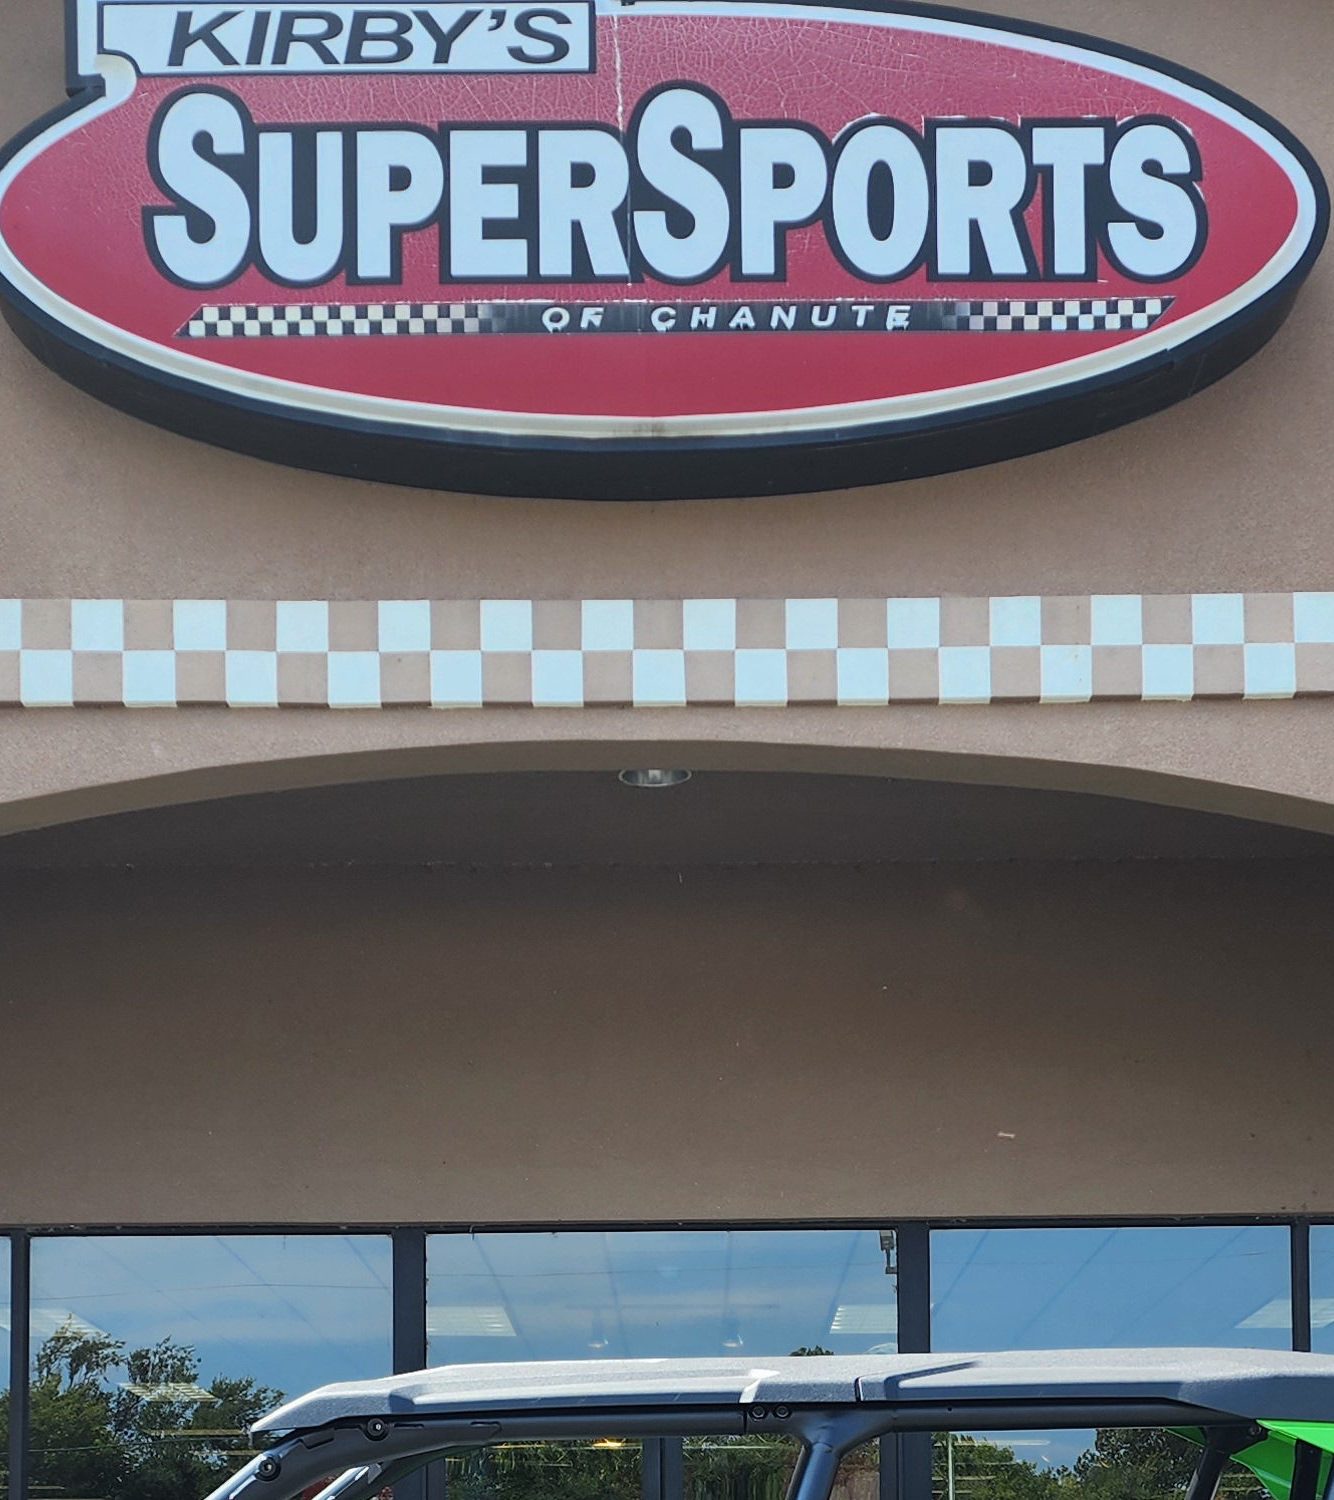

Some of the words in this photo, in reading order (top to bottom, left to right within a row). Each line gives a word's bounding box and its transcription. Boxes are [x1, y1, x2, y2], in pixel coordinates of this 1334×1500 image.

[167, 8, 573, 67] KIRBY'S
[151, 87, 1200, 284] SUPERSPORTS
[542, 306, 605, 333] OF
[651, 305, 913, 331] CHANUTE
